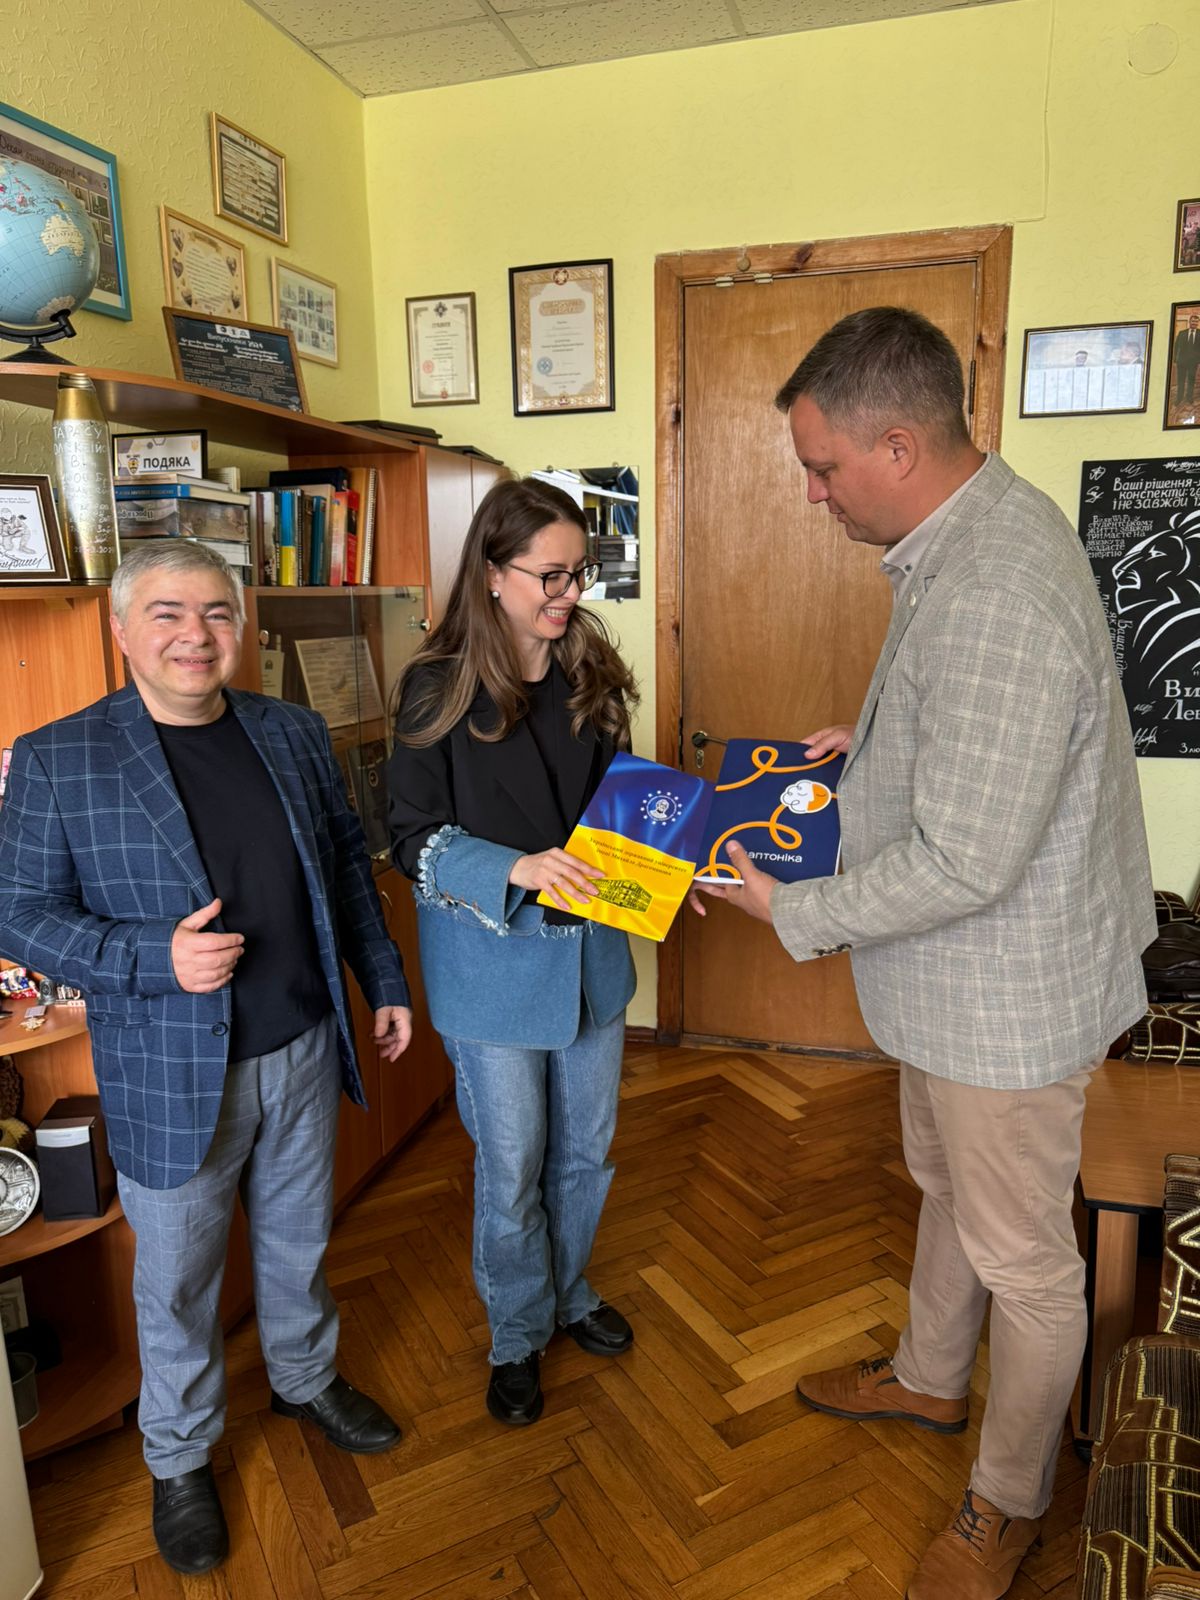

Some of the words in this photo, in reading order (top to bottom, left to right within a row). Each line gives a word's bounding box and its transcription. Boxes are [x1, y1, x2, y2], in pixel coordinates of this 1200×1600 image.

[143, 456, 191, 469] ПОДЯКА
[1113, 477, 1144, 492] Ваші
[1118, 500, 1133, 510] не
[1134, 497, 1188, 509] завжди
[1116, 619, 1133, 651] Ваша
[745, 850, 803, 864] аптоніка
